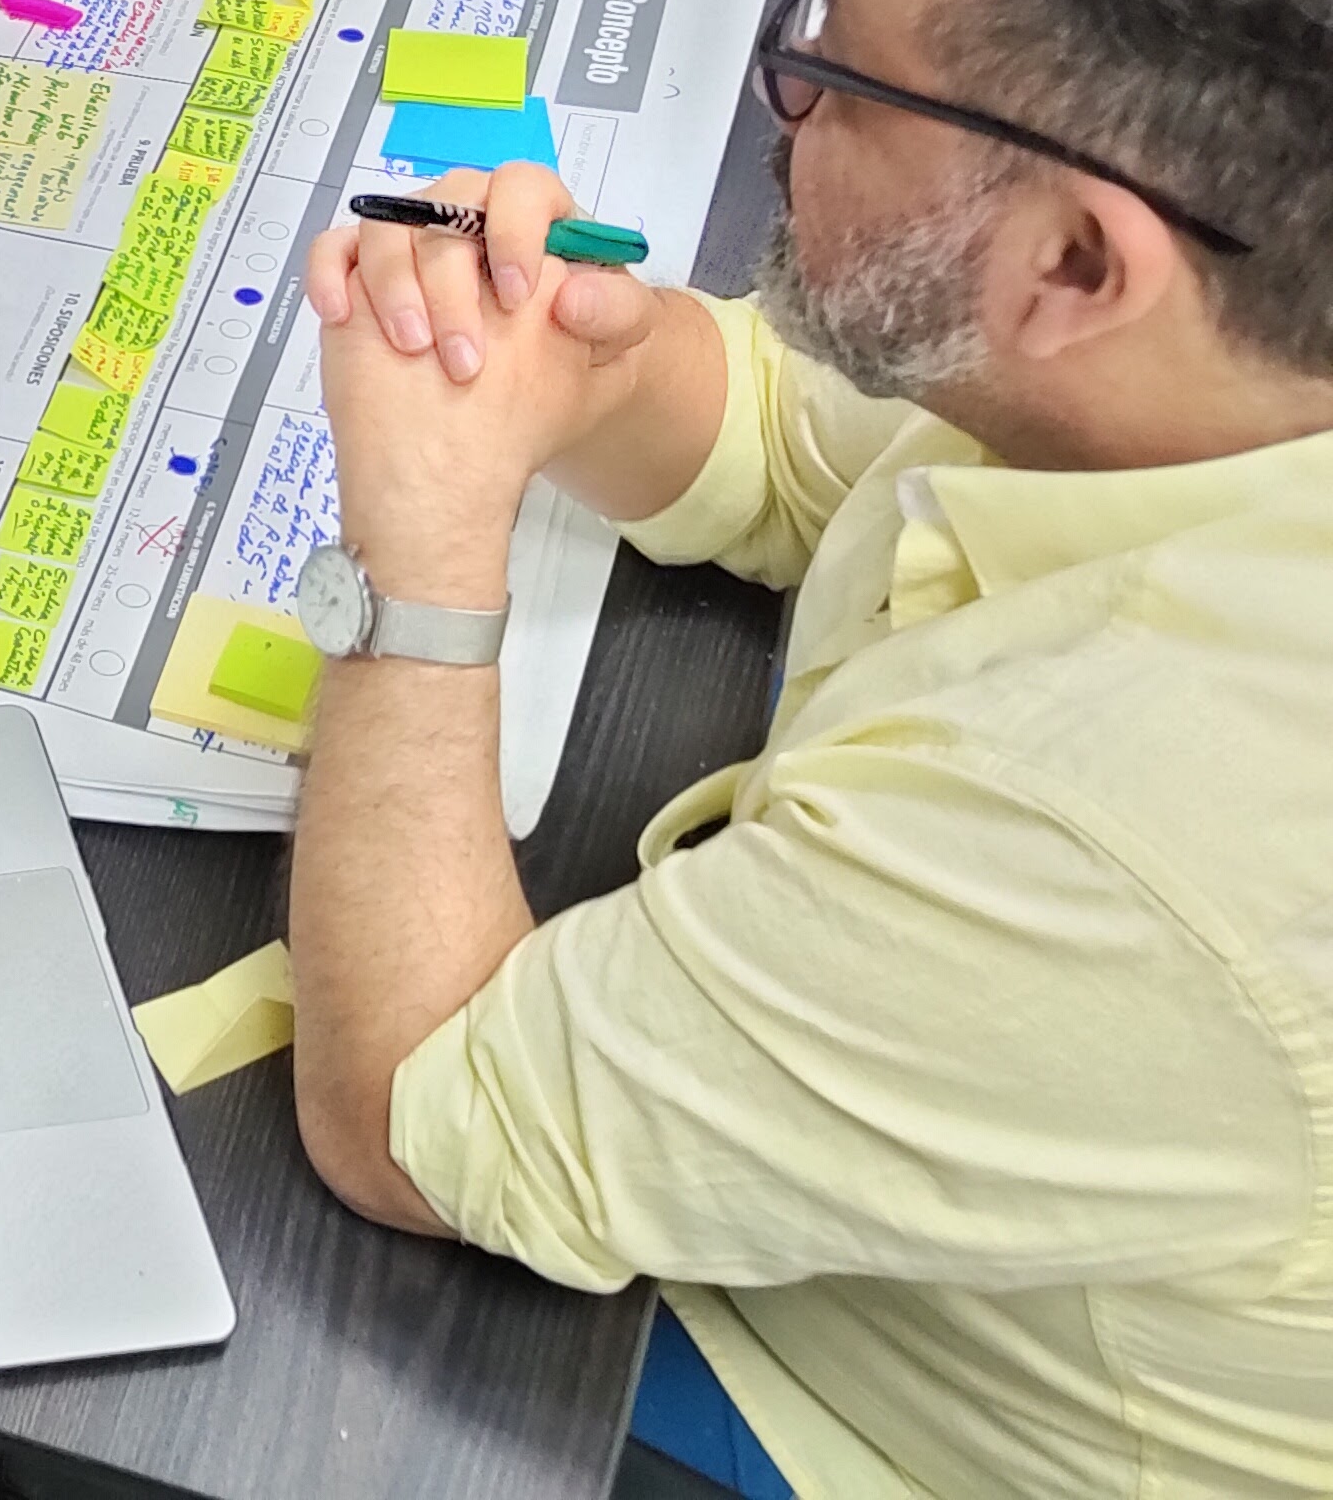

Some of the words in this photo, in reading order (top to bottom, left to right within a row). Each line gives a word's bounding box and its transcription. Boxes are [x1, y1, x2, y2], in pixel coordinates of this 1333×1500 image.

[117, 149, 147, 186] PRUEBA
[61, 292, 81, 308] 10.
[25, 309, 73, 385] SUPOSICIONES
